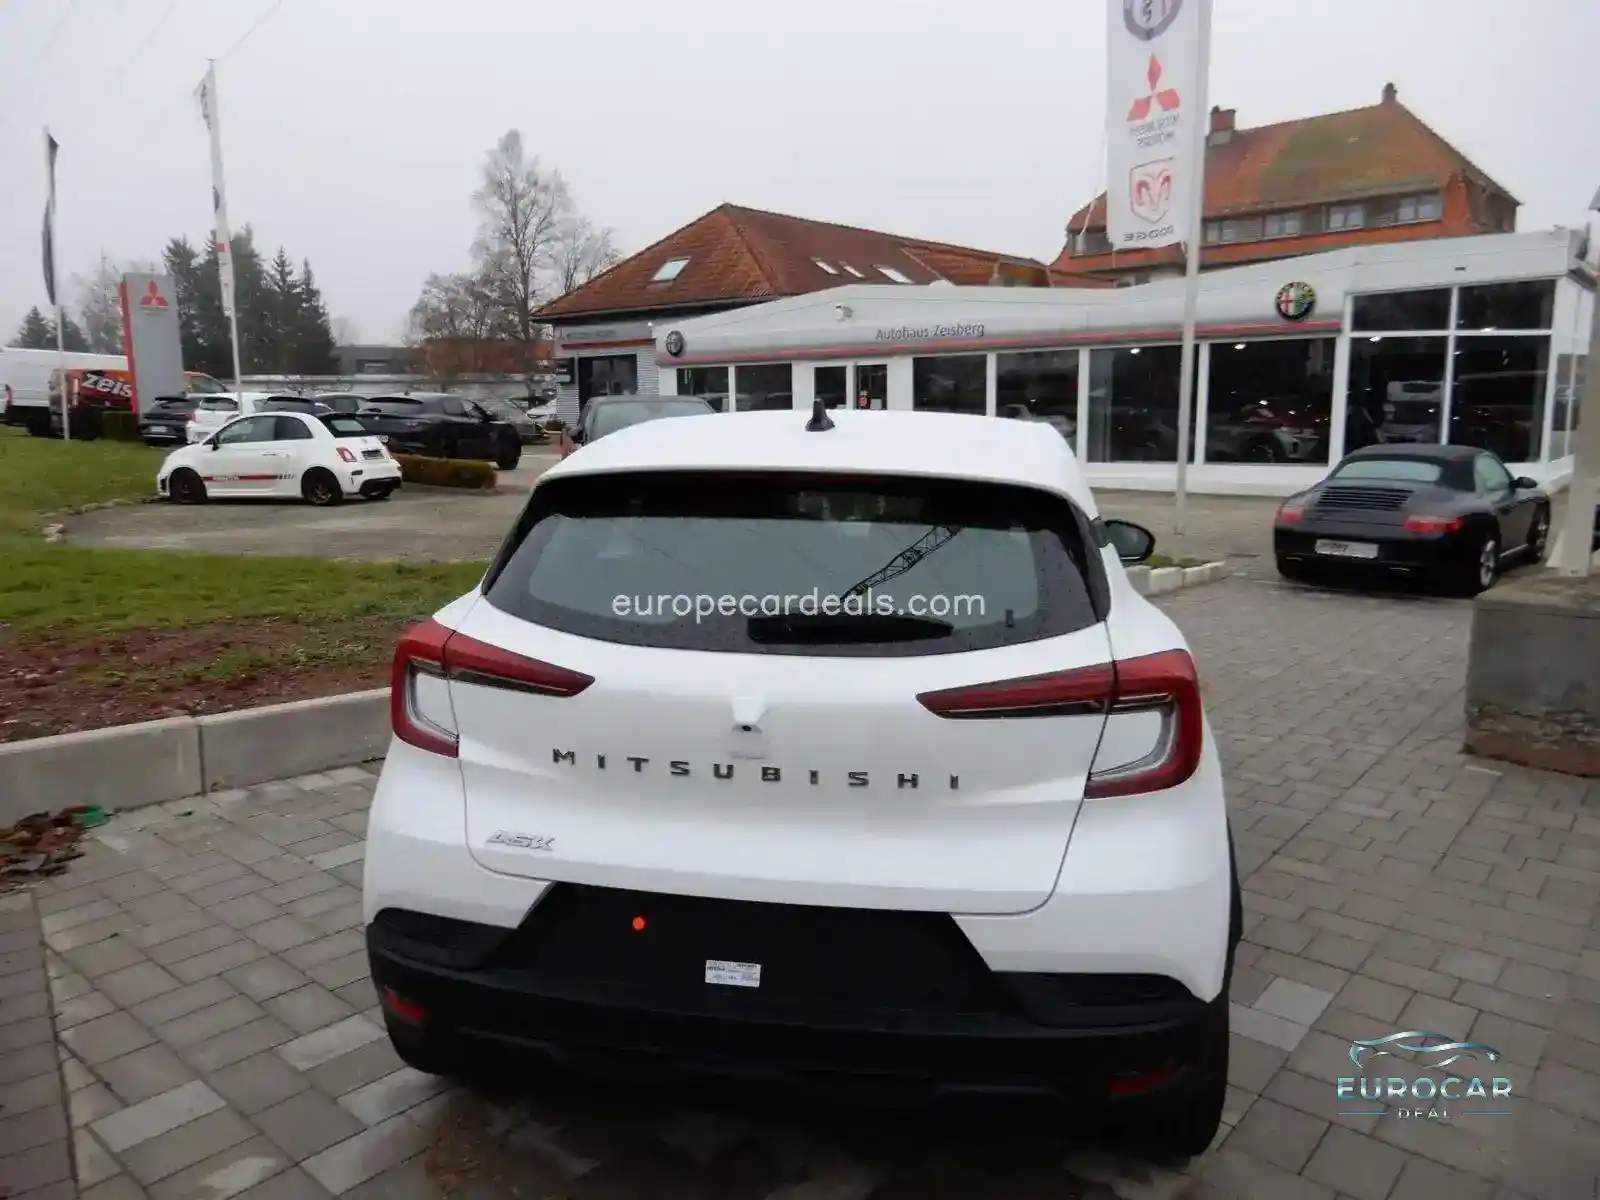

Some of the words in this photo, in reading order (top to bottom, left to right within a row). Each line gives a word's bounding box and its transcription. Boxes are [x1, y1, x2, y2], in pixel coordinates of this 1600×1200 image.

[875, 326, 929, 340] Autohaus
[932, 322, 985, 337] Zeisberg
[552, 747, 960, 791] MITSUBISHI
